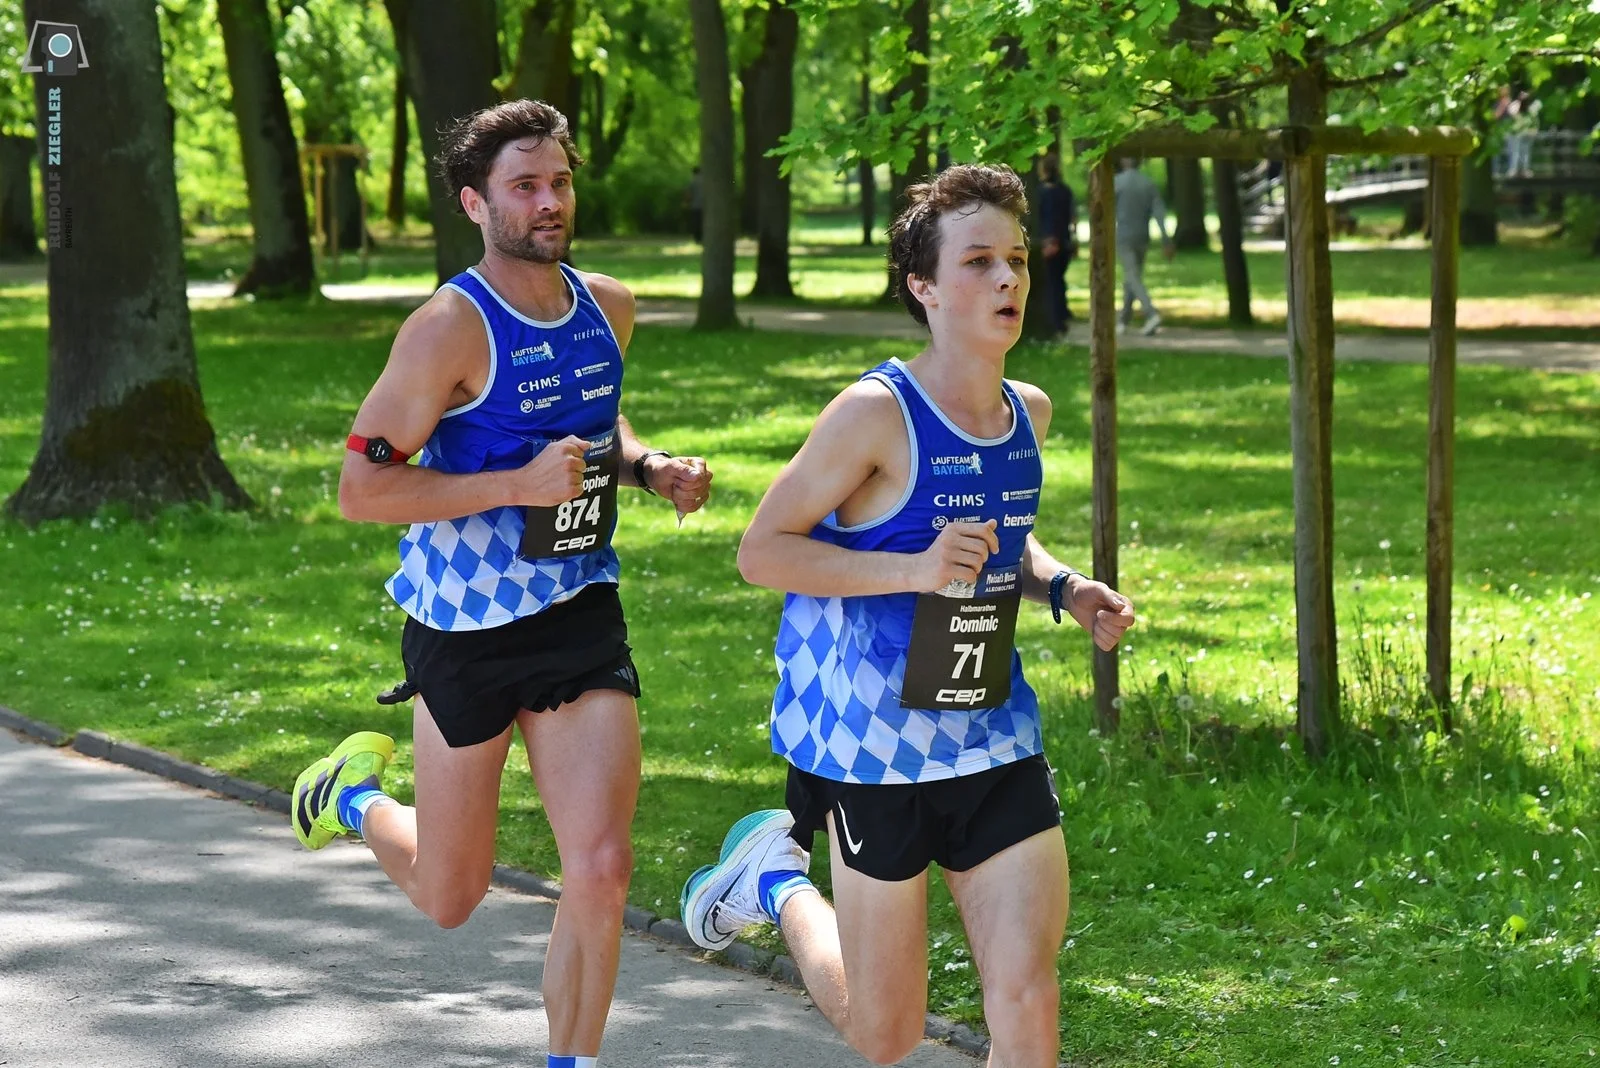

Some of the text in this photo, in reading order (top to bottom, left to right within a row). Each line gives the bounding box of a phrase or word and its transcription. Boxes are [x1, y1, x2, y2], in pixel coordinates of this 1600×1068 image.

[511, 345, 544, 358] LAUFTEAM
[512, 353, 546, 367] BAYERN
[582, 384, 614, 401] bender
[931, 457, 972, 465] LAUFTEAM
[932, 465, 973, 476] BAYERN
[582, 474, 610, 492] opher
[554, 495, 601, 532] 874
[553, 534, 597, 552] cep
[960, 605, 997, 613] Halbmarathon
[949, 615, 999, 633] Dominic
[951, 642, 986, 679] 71
[935, 688, 987, 706] cep
